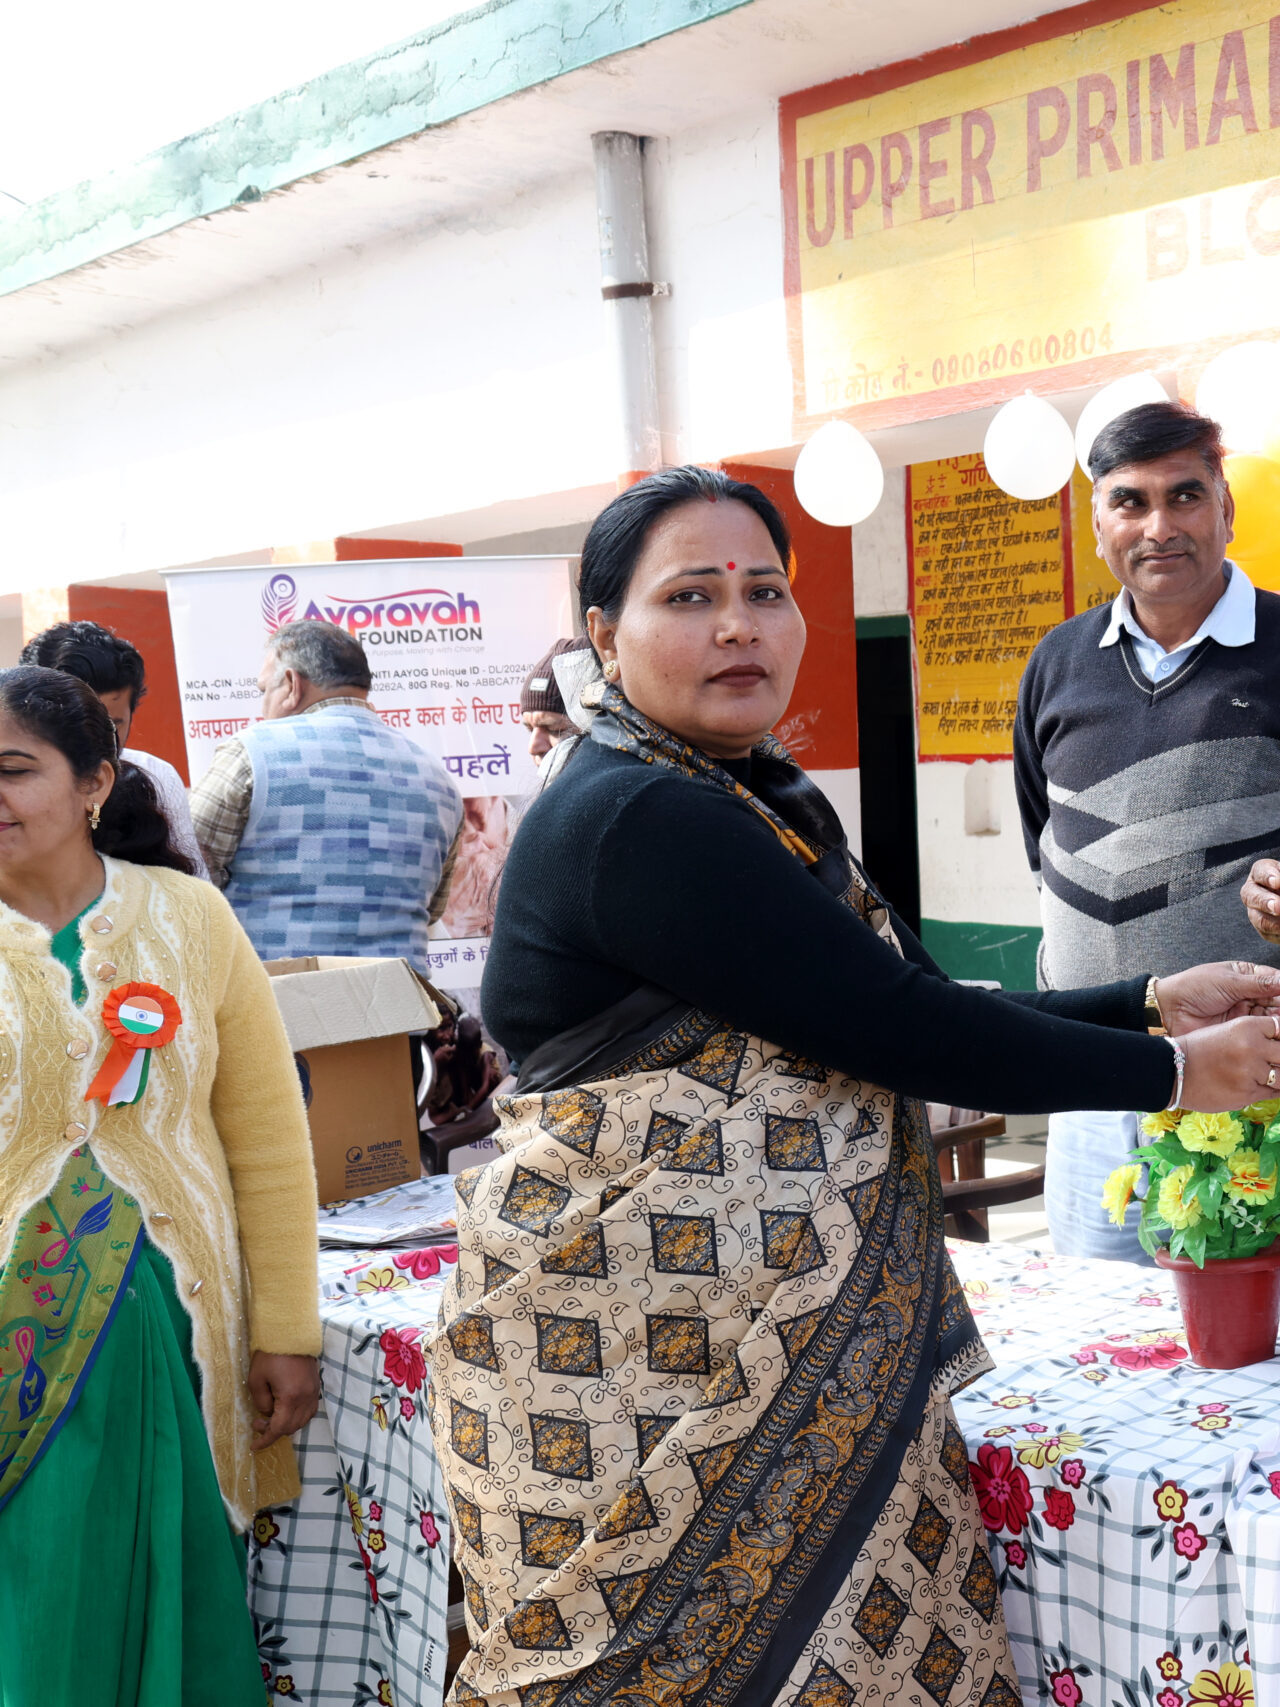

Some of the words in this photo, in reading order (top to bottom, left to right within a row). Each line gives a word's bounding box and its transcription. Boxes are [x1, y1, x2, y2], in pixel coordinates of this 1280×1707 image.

[803, 108, 996, 248] UPPER
[359, 626, 483, 648] FOUNDATION
[185, 692, 203, 702] PAN
[206, 692, 221, 701] No
[408, 680, 428, 690] 80G
[455, 677, 470, 688] No
[186, 680, 208, 690] MCA
[393, 667, 429, 679] AAYOG
[432, 667, 467, 679] Unique
[469, 665, 480, 676] ID
[415, 706, 446, 726] कल
[450, 697, 467, 725] के
[472, 696, 503, 725] लिए
[442, 743, 511, 779] पहलें
[462, 946, 476, 963] के
